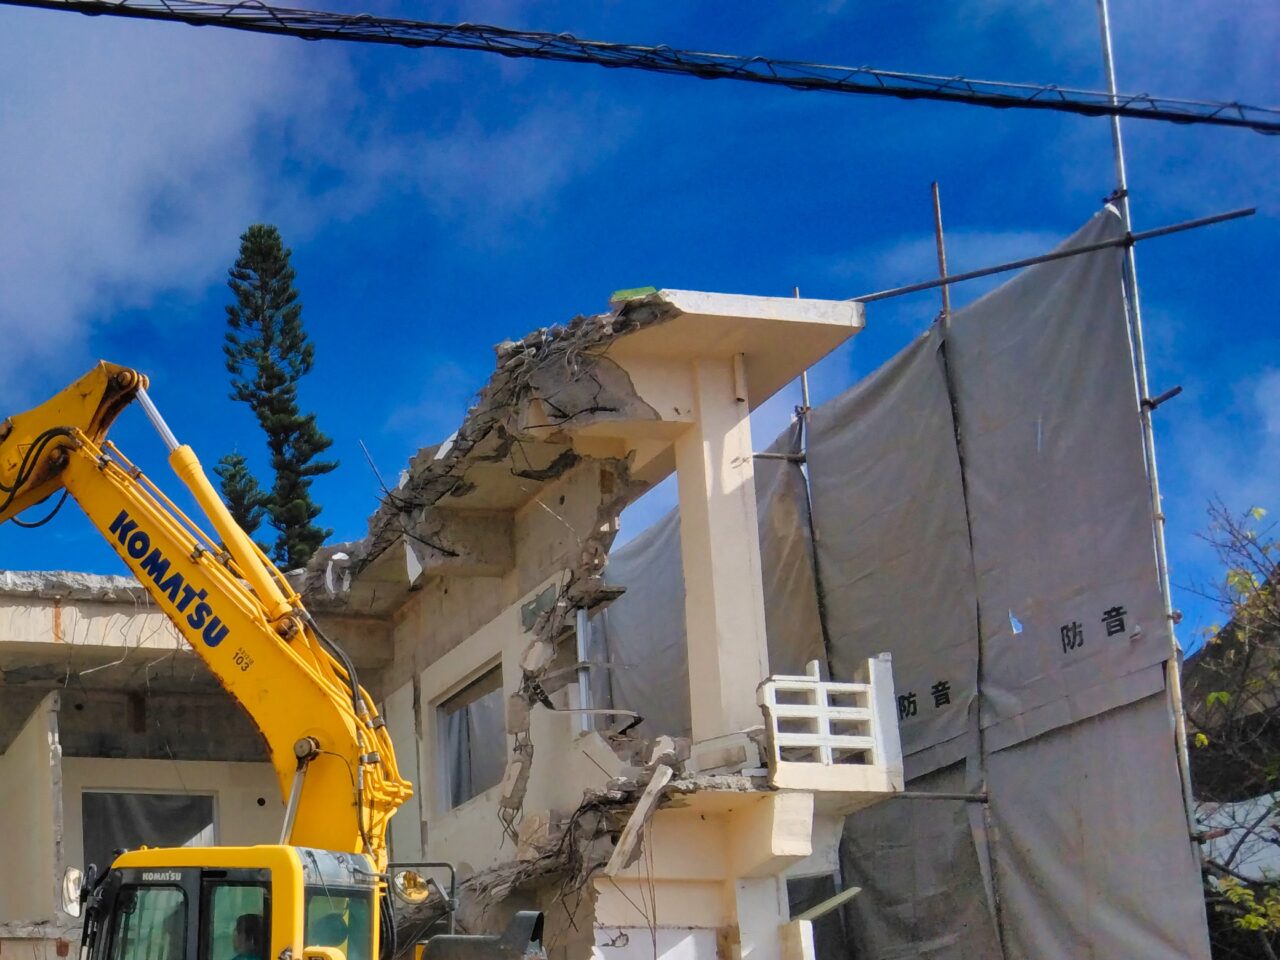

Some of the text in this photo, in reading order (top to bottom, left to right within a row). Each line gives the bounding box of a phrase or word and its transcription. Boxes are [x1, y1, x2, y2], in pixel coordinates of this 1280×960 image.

[108, 509, 230, 648] KOMATSU
[1060, 605, 1128, 654] 防音
[232, 651, 250, 672] 103
[898, 680, 951, 721] 防音
[142, 869, 182, 881] KOMATSU
